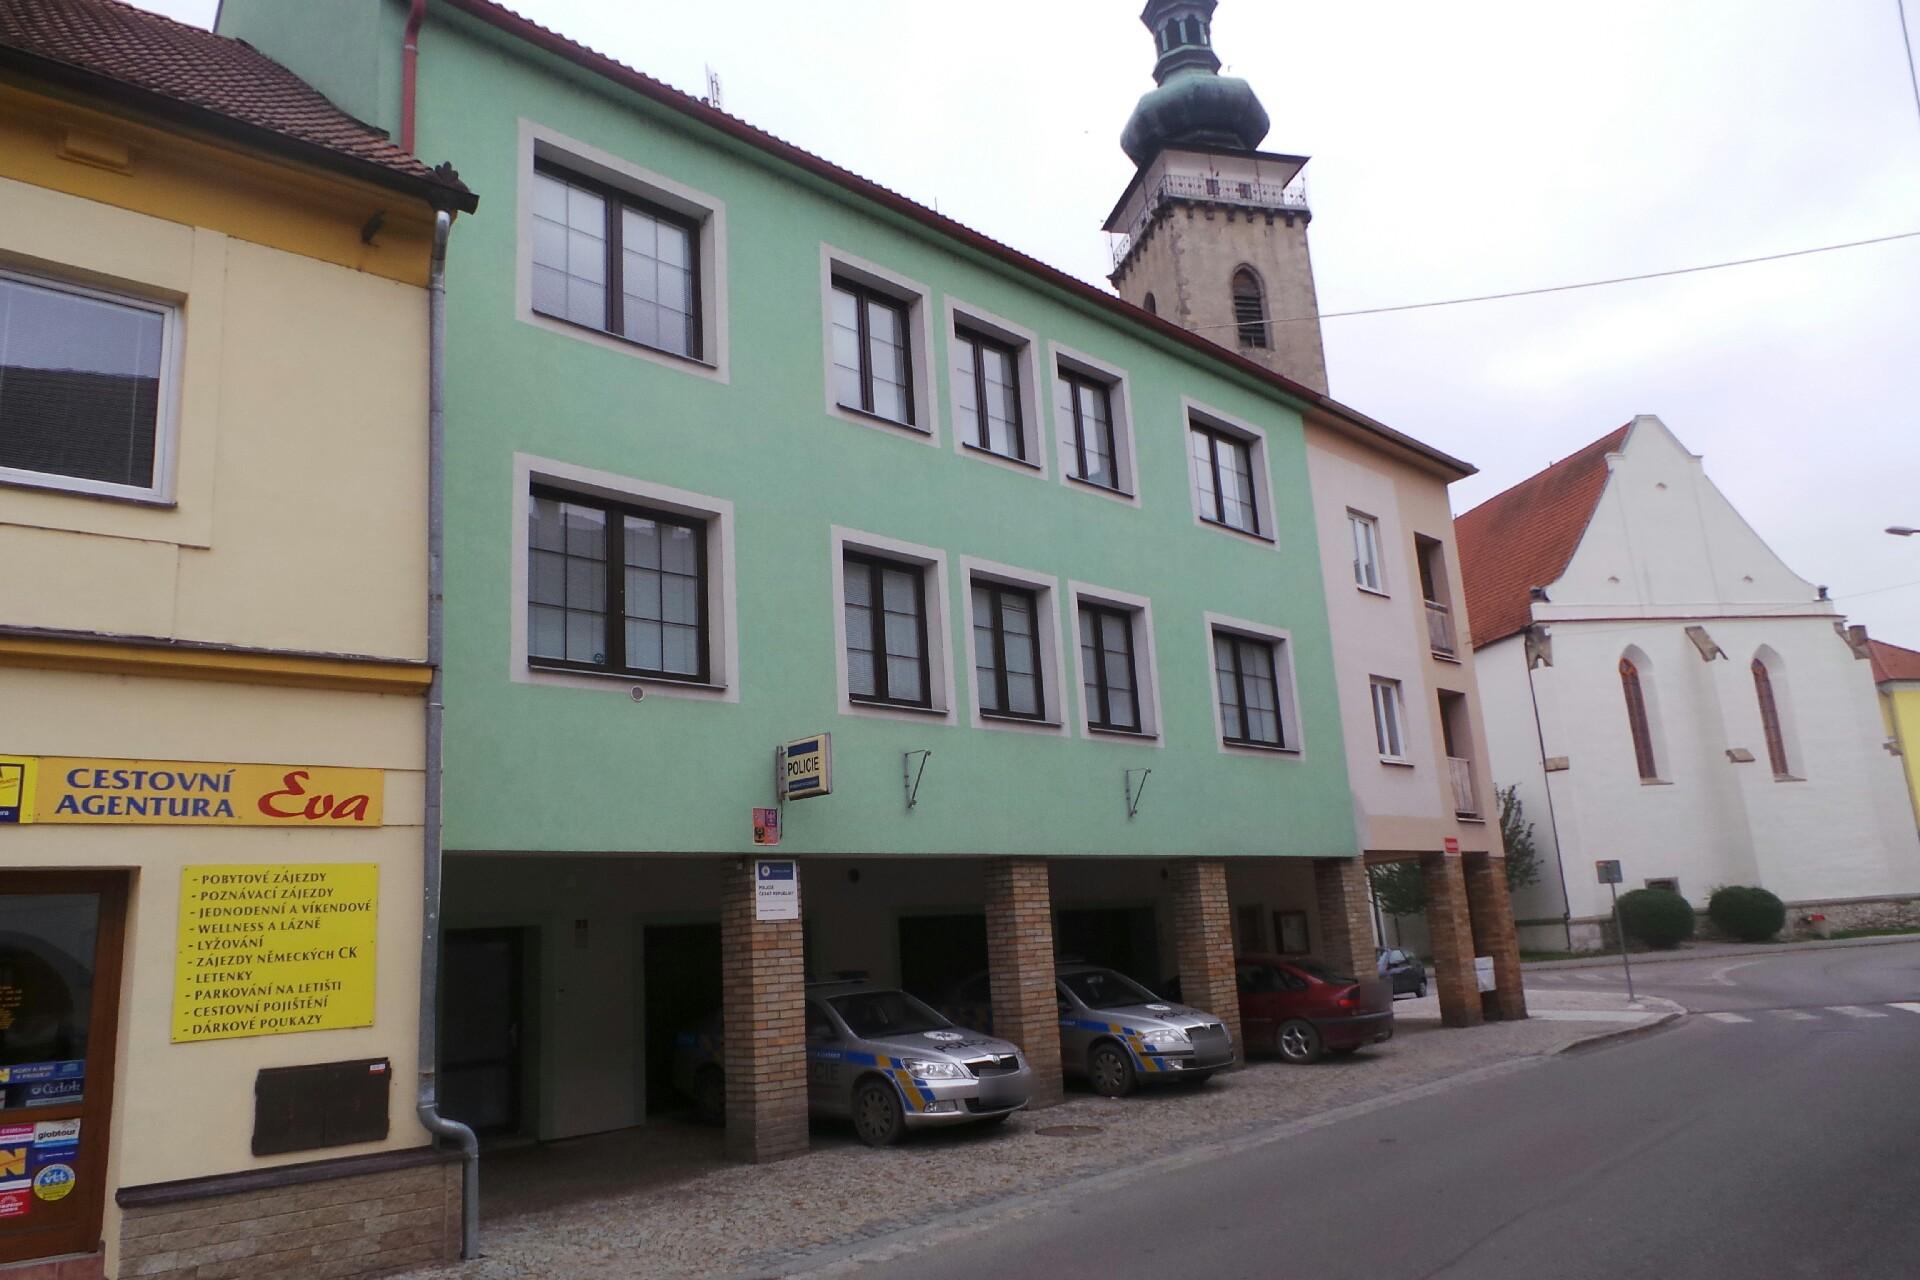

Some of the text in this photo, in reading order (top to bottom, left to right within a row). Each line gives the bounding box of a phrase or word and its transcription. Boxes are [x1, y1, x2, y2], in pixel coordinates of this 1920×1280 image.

[788, 757, 819, 776] POLICIE
[66, 768, 370, 821] CESTOVNÍ Eva
[54, 794, 236, 818] AGENTURA
[202, 870, 327, 885] POBYTOVÉ ZÁJEZDY
[200, 885, 334, 901] POZNÁVACÍ ZÁJEZDY
[199, 898, 372, 919] JEDNODENNÍ A VÍKENDOVÉ
[199, 916, 321, 934] WELLNESS A LÁZNĚ
[197, 934, 264, 951] LYŽOVÁNÍ
[195, 946, 358, 968] ZÁJEZDY NĚMECKÝCH CK
[195, 970, 253, 984] LETENKY
[194, 979, 342, 1001] PARKOVÁNÍ NA LETIŠTI
[193, 994, 329, 1018] CESTOVNÍ POJIŠTĚNÍ
[191, 1014, 322, 1035] DÁRKOVÉ POUKAZY
[38, 1129, 76, 1140] globtour
